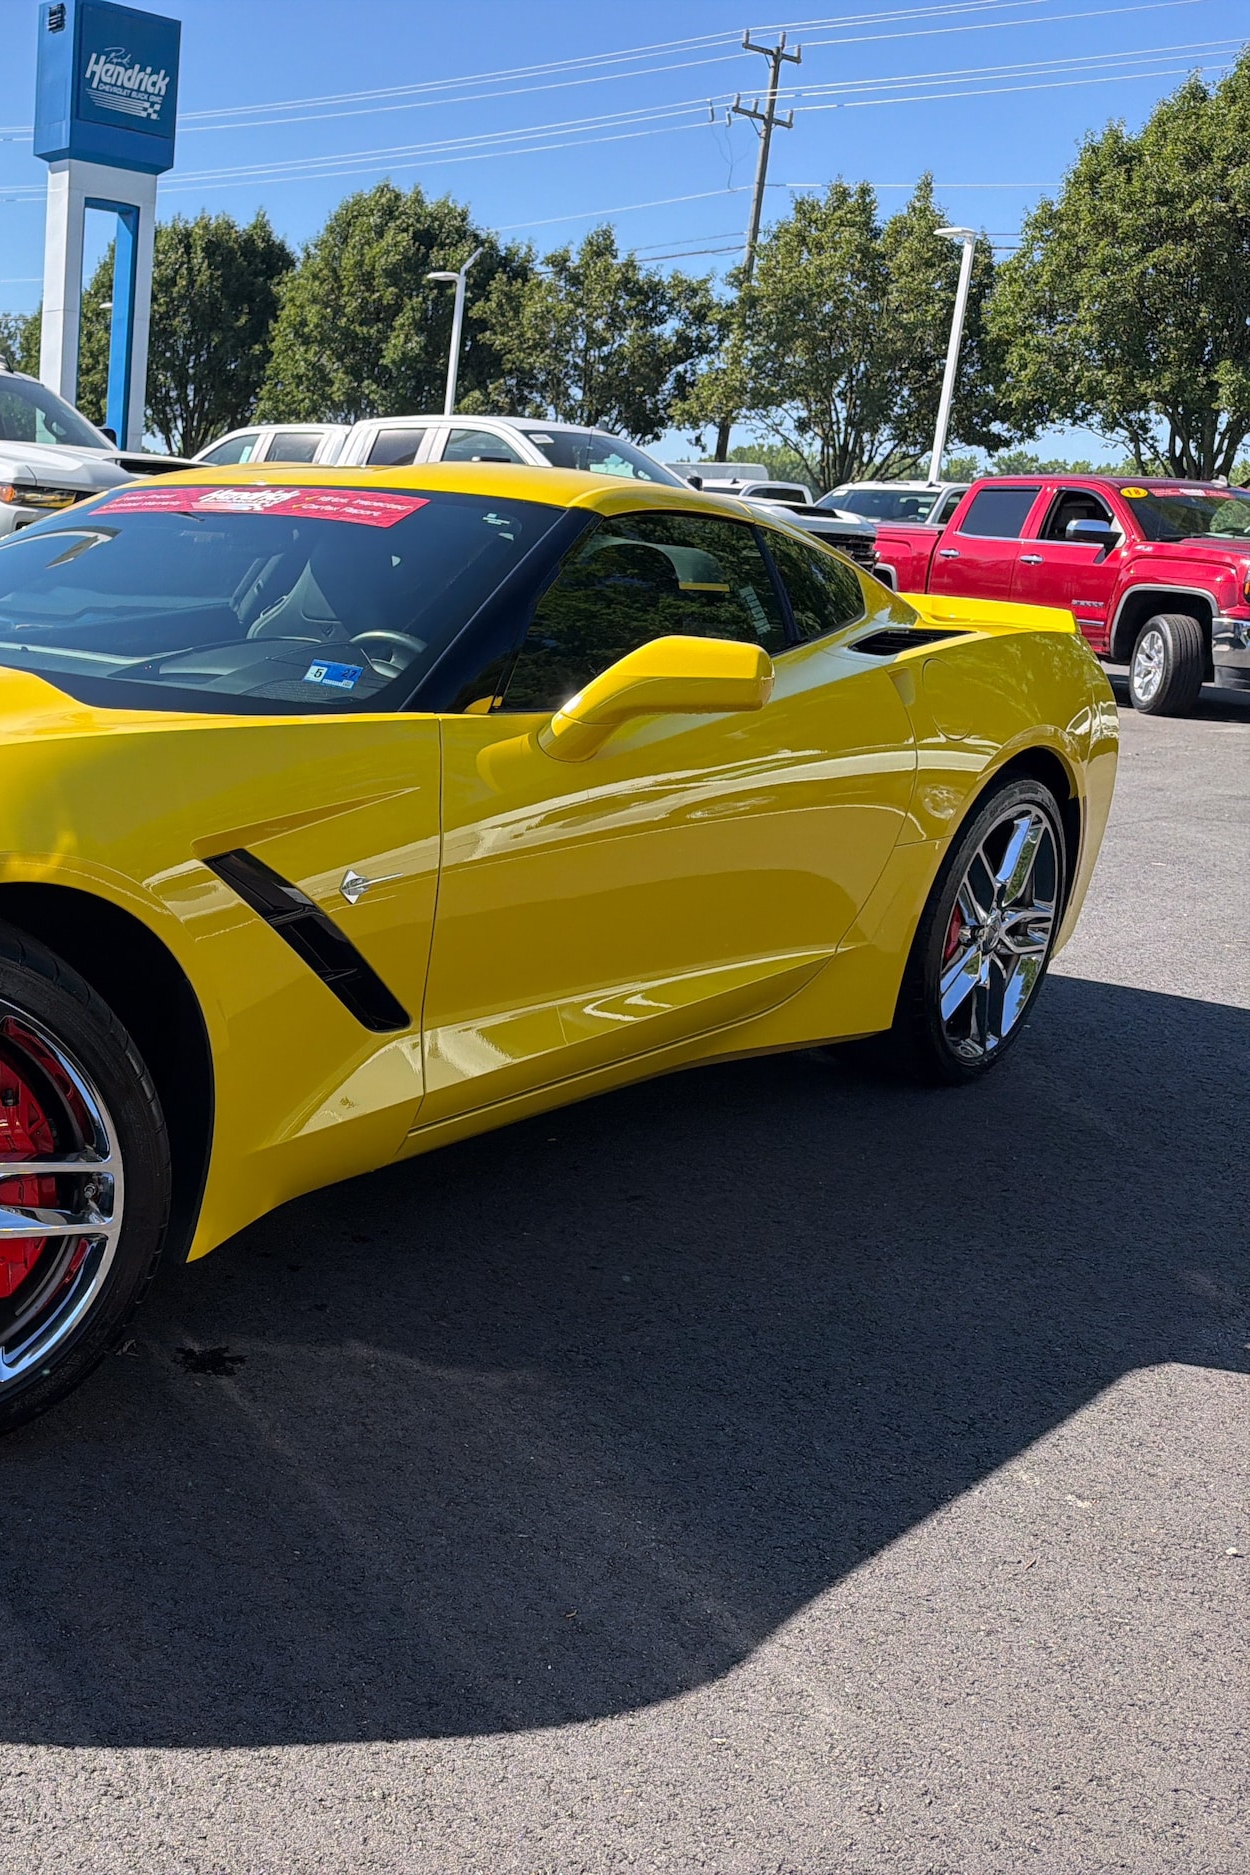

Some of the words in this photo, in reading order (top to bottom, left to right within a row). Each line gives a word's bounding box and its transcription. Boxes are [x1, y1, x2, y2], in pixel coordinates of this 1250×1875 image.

[85, 52, 170, 96] Hendrick
[98, 82, 131, 97] CHEVROLET
[131, 91, 149, 101] BUICK
[313, 668, 325, 678] 5
[342, 668, 357, 679] 27
